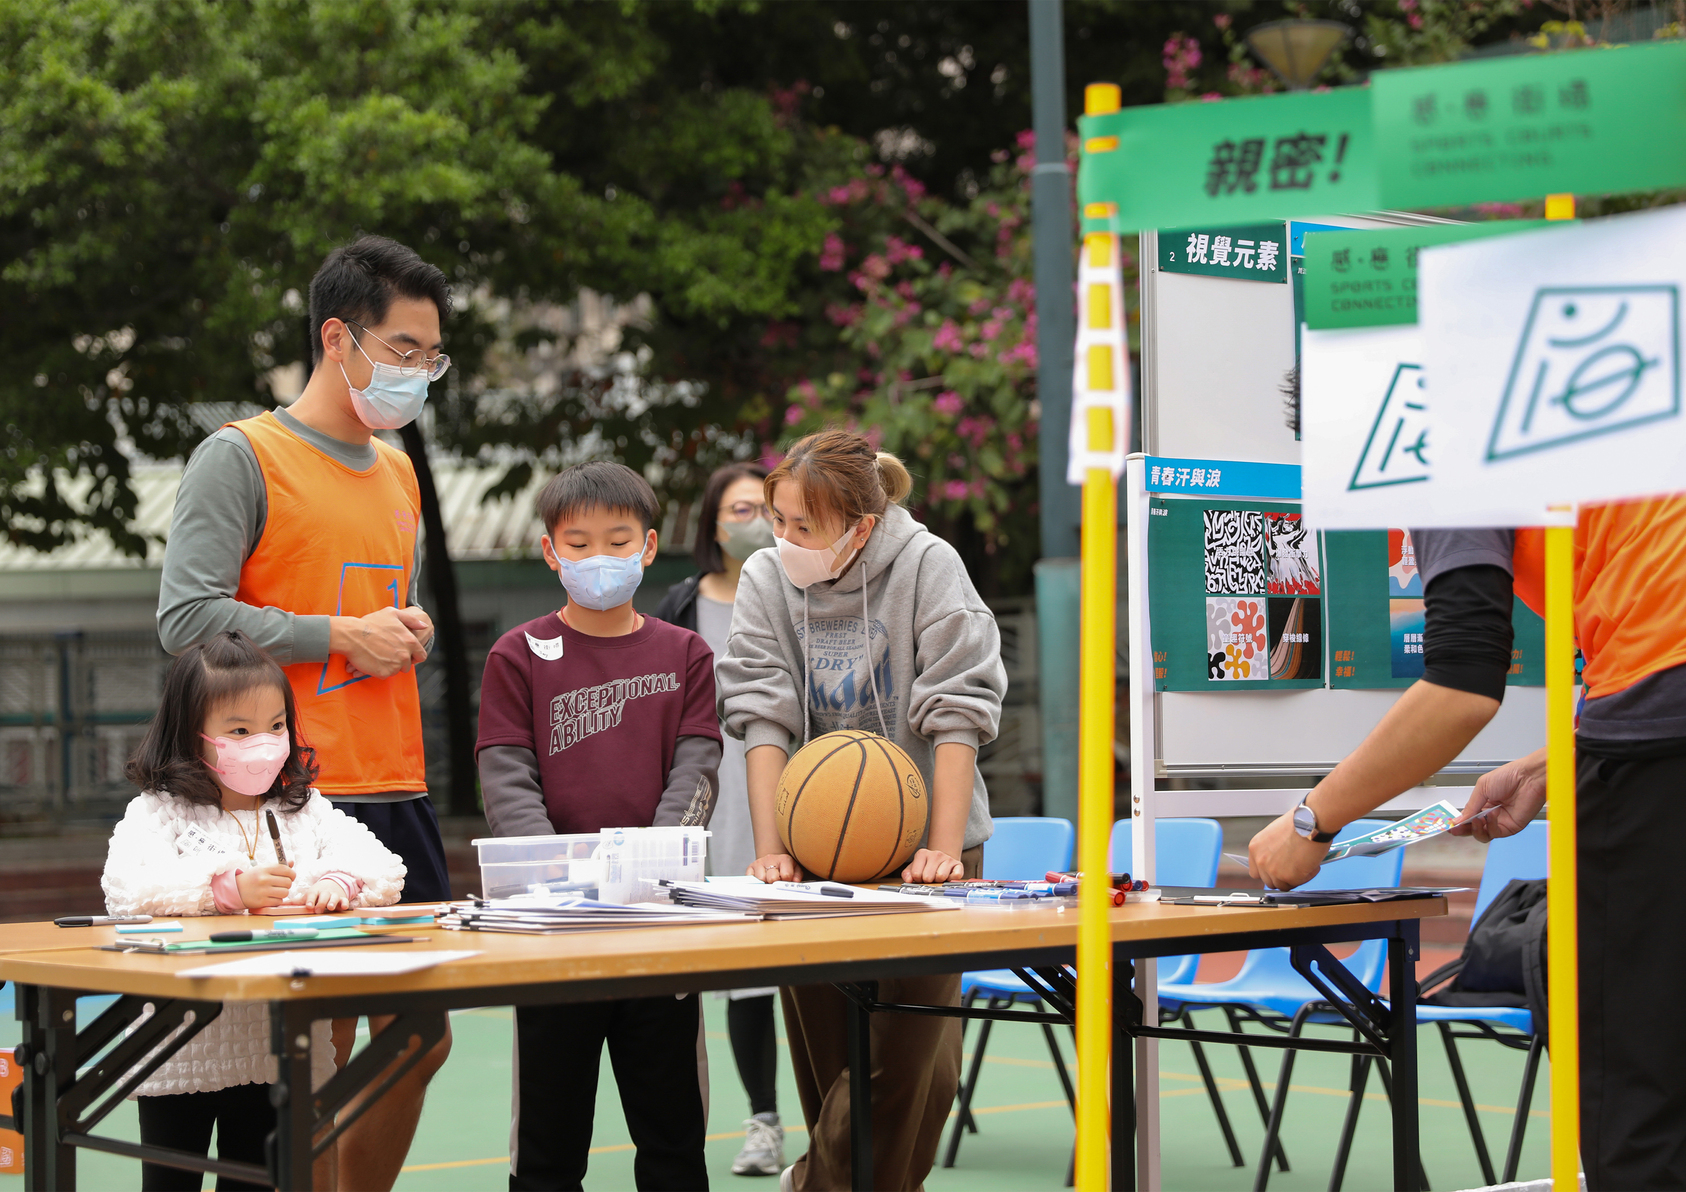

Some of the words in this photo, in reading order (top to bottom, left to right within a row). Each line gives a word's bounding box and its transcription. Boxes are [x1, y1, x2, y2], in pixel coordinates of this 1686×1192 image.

[1206, 131, 1349, 196] 親密!
[1169, 251, 1175, 262] 2
[1185, 233, 1279, 271] 視覺元素
[1330, 279, 1393, 294] SPORTS
[1151, 465, 1221, 487] 青春汗與淚
[809, 620, 858, 633] BREWERIES
[1510, 649, 1523, 660] 力!
[1335, 666, 1355, 677] 幸福!
[550, 672, 680, 726] EXCEPTIONAL
[549, 700, 626, 756] ABILITY
